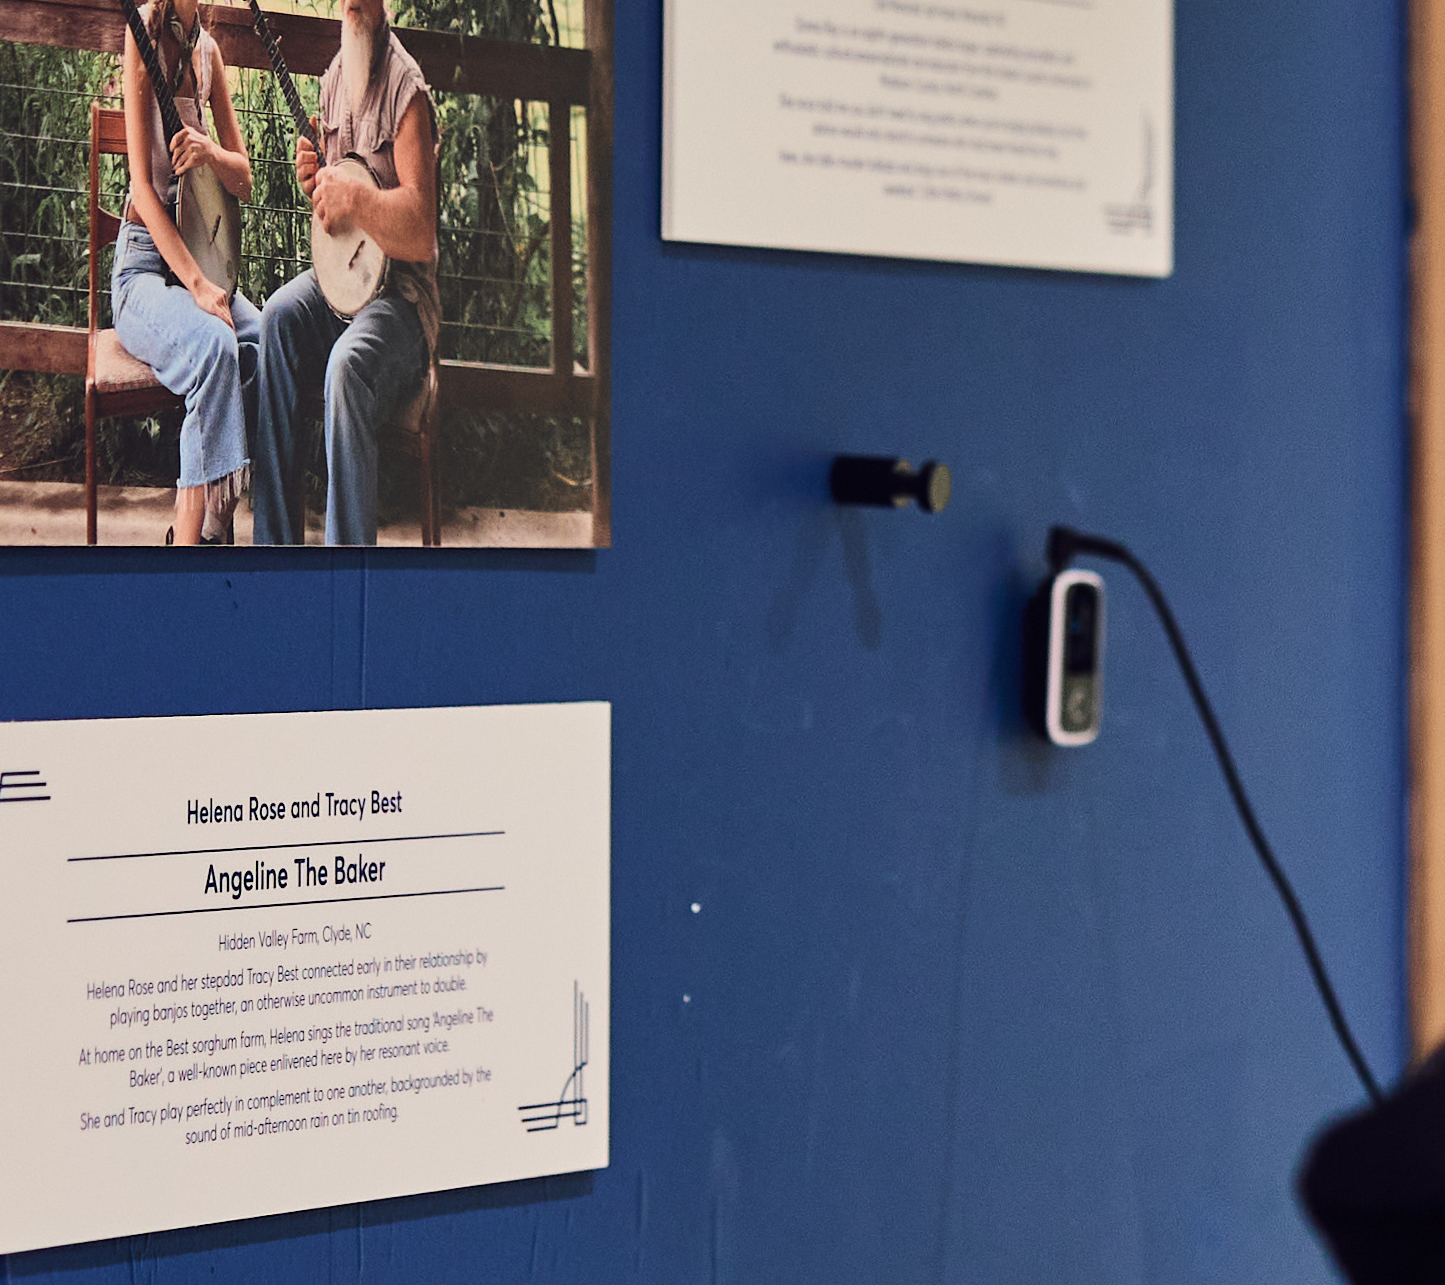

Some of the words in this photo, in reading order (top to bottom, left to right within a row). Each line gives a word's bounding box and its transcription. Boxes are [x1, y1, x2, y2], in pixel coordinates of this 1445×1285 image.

[186, 797, 243, 824] Helena
[248, 796, 286, 821] Rose
[289, 792, 320, 818] and
[324, 792, 366, 821] Tracy
[370, 789, 403, 814] Best
[203, 860, 288, 899] Angeline
[293, 856, 328, 887] The
[334, 853, 386, 884] Baker
[218, 932, 255, 951] Hidden
[257, 929, 289, 950] Valley
[291, 927, 319, 945] Farm,
[321, 923, 353, 945] Clyde,
[354, 921, 372, 939] NC
[86, 980, 125, 999] Helena
[127, 978, 154, 996] Rose
[156, 974, 178, 993] and
[180, 973, 198, 991] her
[200, 968, 244, 991] stepdad
[246, 967, 274, 987] Tracy
[277, 964, 299, 982] Best
[301, 958, 354, 979] connected
[356, 956, 381, 977] early
[383, 956, 392, 972] in
[394, 953, 417, 971] their
[418, 949, 474, 968] relationship
[475, 947, 487, 966] by
[109, 1006, 150, 1029] playing
[152, 1002, 188, 1023] banjos
[190, 997, 238, 1020] together,
[239, 999, 254, 1012] an
[255, 991, 305, 1010] otherwise
[307, 988, 364, 1005] uncommon
[366, 980, 418, 999] instrument
[420, 978, 431, 994] to
[78, 1047, 91, 1066] At
[94, 1046, 125, 1064] home
[127, 1046, 142, 1060] on
[145, 1040, 163, 1059] the
[165, 1038, 189, 1056] Best
[191, 1033, 237, 1056] sorghum
[239, 1030, 267, 1048] farm,
[269, 1026, 305, 1045] Helena
[307, 1024, 333, 1044] sings
[335, 1020, 352, 1038] the
[353, 1014, 404, 1036] traditional
[406, 1016, 430, 1033] song
[475, 1005, 494, 1022] The
[166, 1070, 175, 1083] a
[177, 1062, 237, 1081] well-known
[239, 1057, 267, 1079] piece
[269, 1049, 318, 1071] enlivened
[320, 1048, 343, 1065] here
[344, 1045, 358, 1066] by
[359, 1044, 376, 1061] her
[378, 1040, 420, 1059] resonant
[79, 1111, 101, 1130] She
[103, 1107, 125, 1127] and
[127, 1106, 157, 1126] Tracy
[159, 1102, 184, 1124] play
[185, 1095, 232, 1121] perfectly
[234, 1095, 244, 1111] in
[246, 1087, 311, 1111] complement
[313, 1086, 324, 1102] to
[325, 1086, 346, 1100] one
[390, 1069, 460, 1094] backgrounded
[461, 1067, 474, 1087] by
[475, 1065, 492, 1082] the
[185, 1123, 217, 1144] sound
[219, 1121, 232, 1140] of
[233, 1117, 307, 1137] mid-afternoon
[309, 1111, 329, 1128] rain
[331, 1112, 345, 1126] on
[347, 1107, 360, 1124] tin
